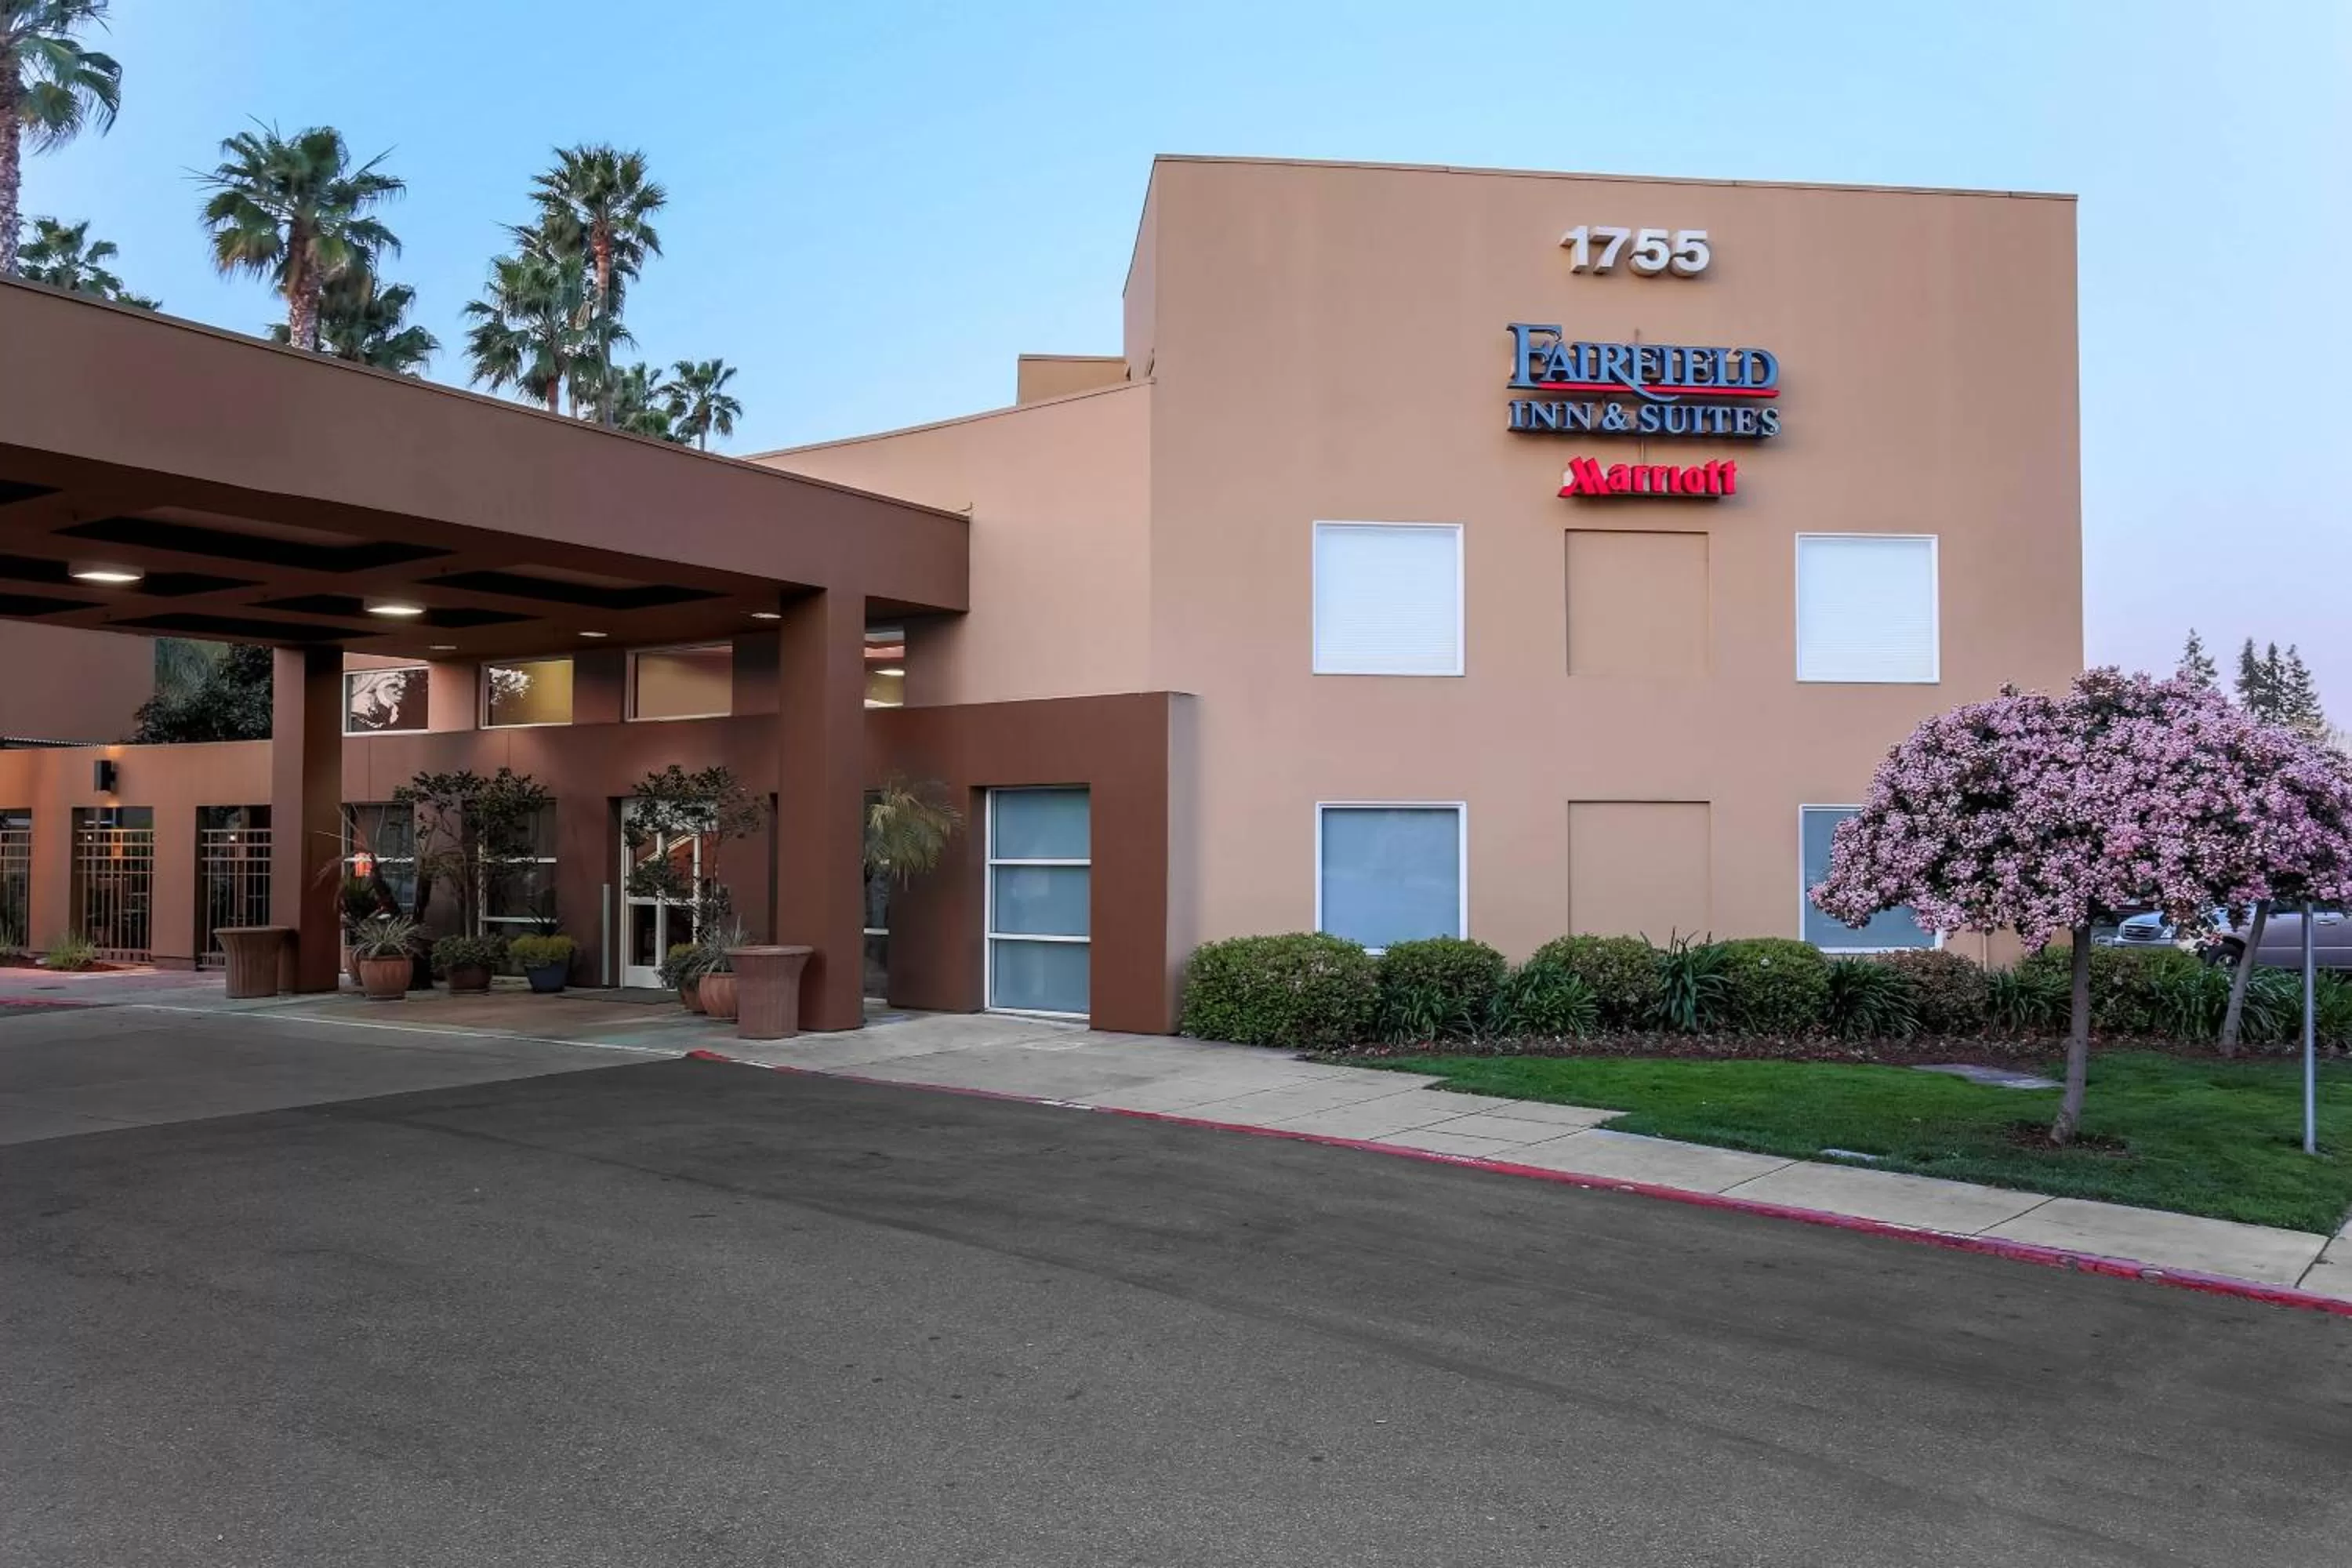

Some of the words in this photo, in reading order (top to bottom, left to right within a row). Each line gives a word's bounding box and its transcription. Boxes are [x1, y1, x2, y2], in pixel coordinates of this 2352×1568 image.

[1559, 225, 1711, 277] 1755
[1506, 322, 1780, 401] FAIRFIELD
[1508, 401, 1595, 431] INN
[1602, 401, 1631, 431] &
[1639, 404, 1781, 437] SUITES
[1557, 456, 1737, 498] Marriott
